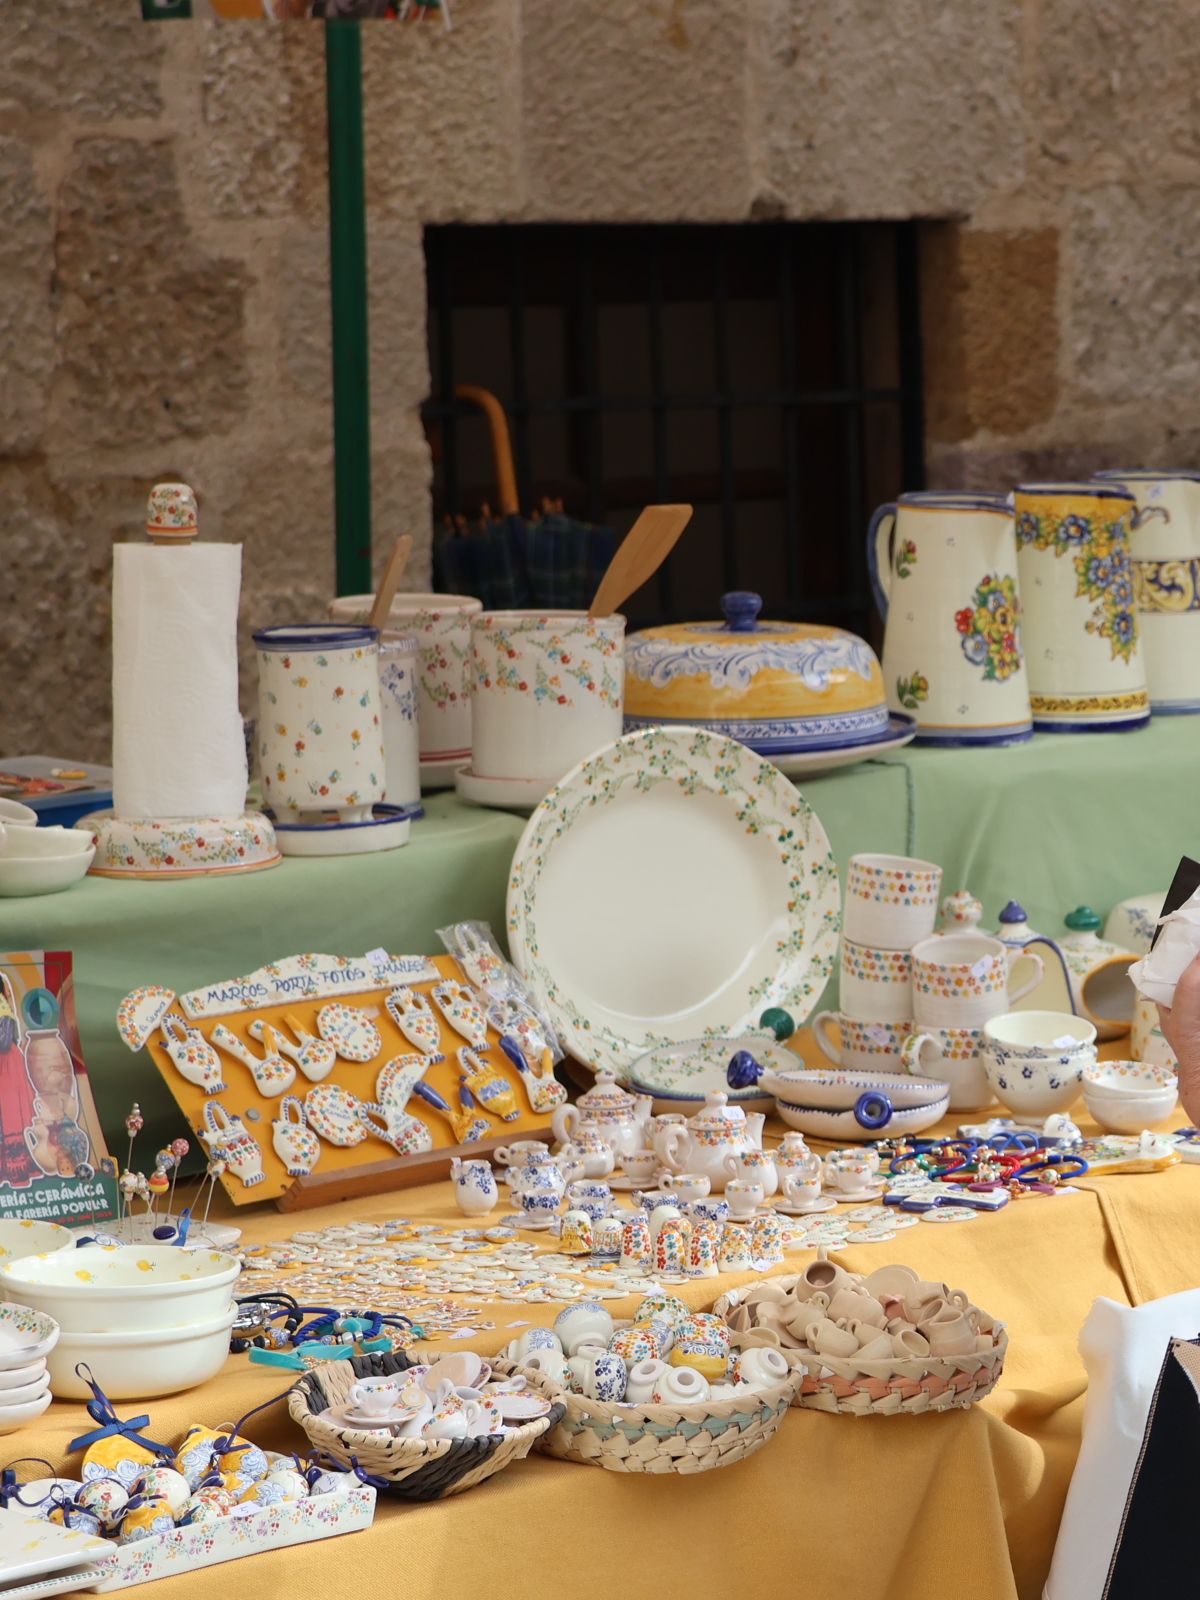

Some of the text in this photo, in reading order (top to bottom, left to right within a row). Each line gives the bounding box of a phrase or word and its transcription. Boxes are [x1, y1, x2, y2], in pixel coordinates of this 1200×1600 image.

[207, 983, 268, 1003] MARCOS
[271, 975, 318, 993] PORTA
[318, 968, 366, 985] FOTOS
[61, 1198, 109, 1215] POPULAR
